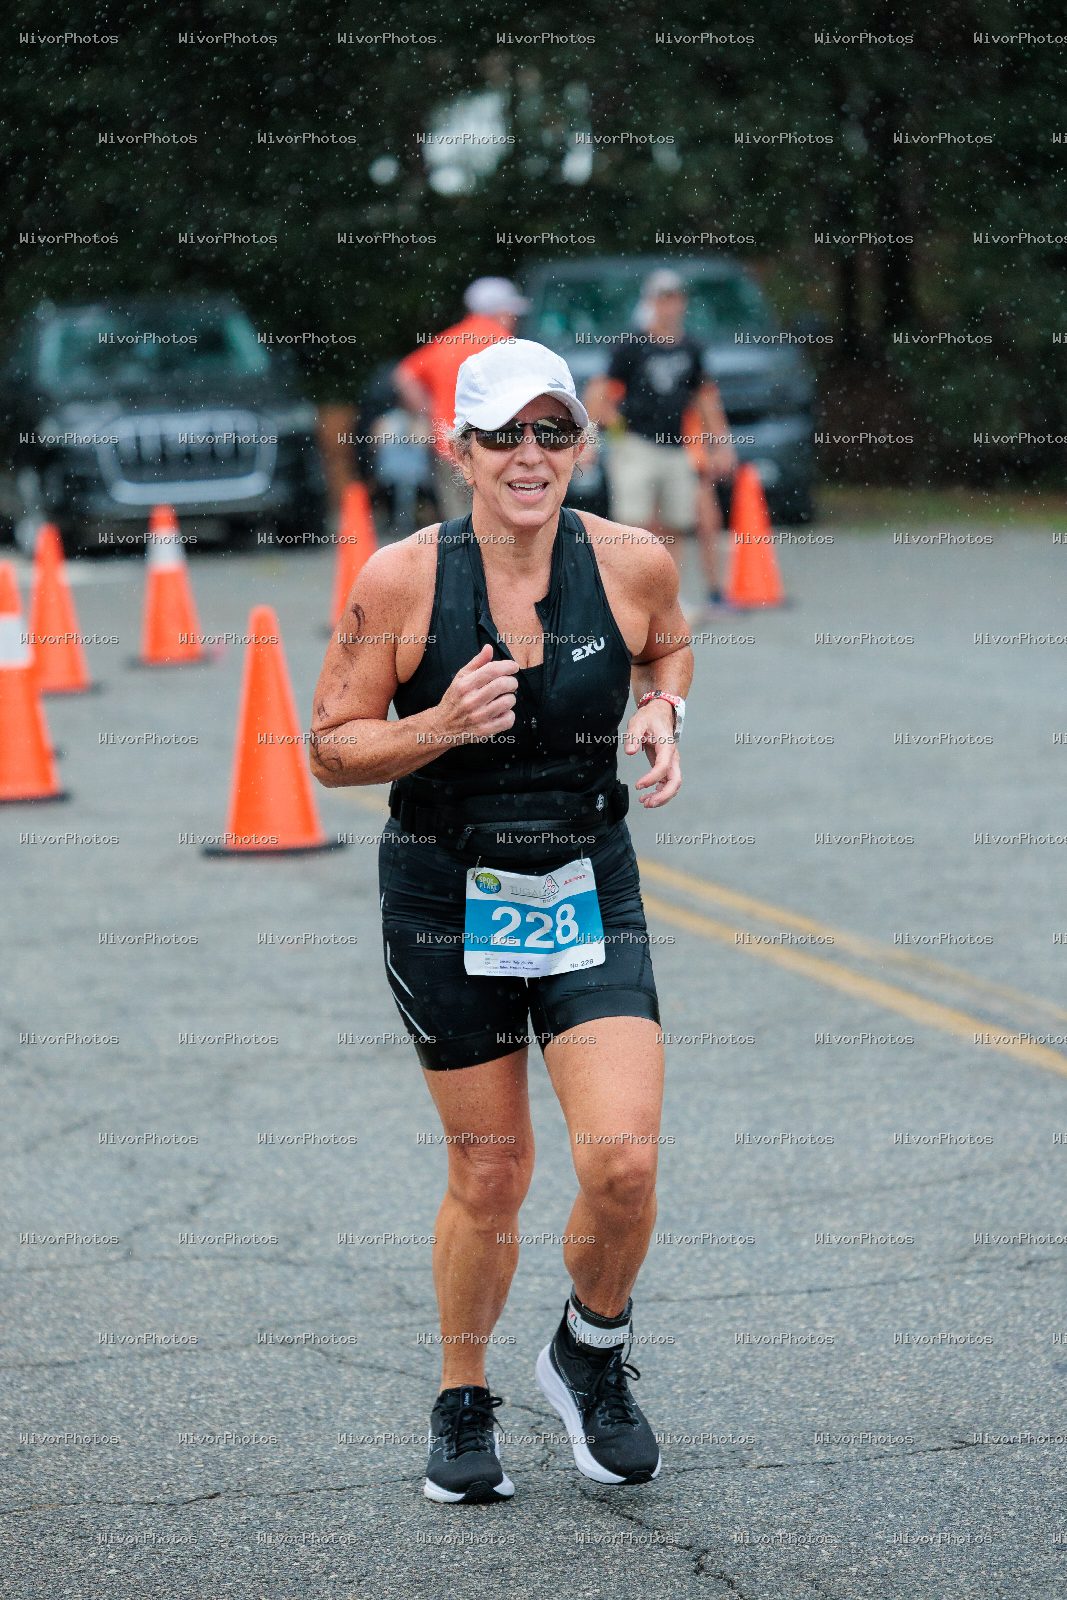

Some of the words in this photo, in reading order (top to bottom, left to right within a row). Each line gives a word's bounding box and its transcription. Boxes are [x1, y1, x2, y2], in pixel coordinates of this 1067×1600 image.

[571, 636, 605, 662] 2XU
[490, 903, 579, 949] 228
[580, 958, 594, 967] 228
